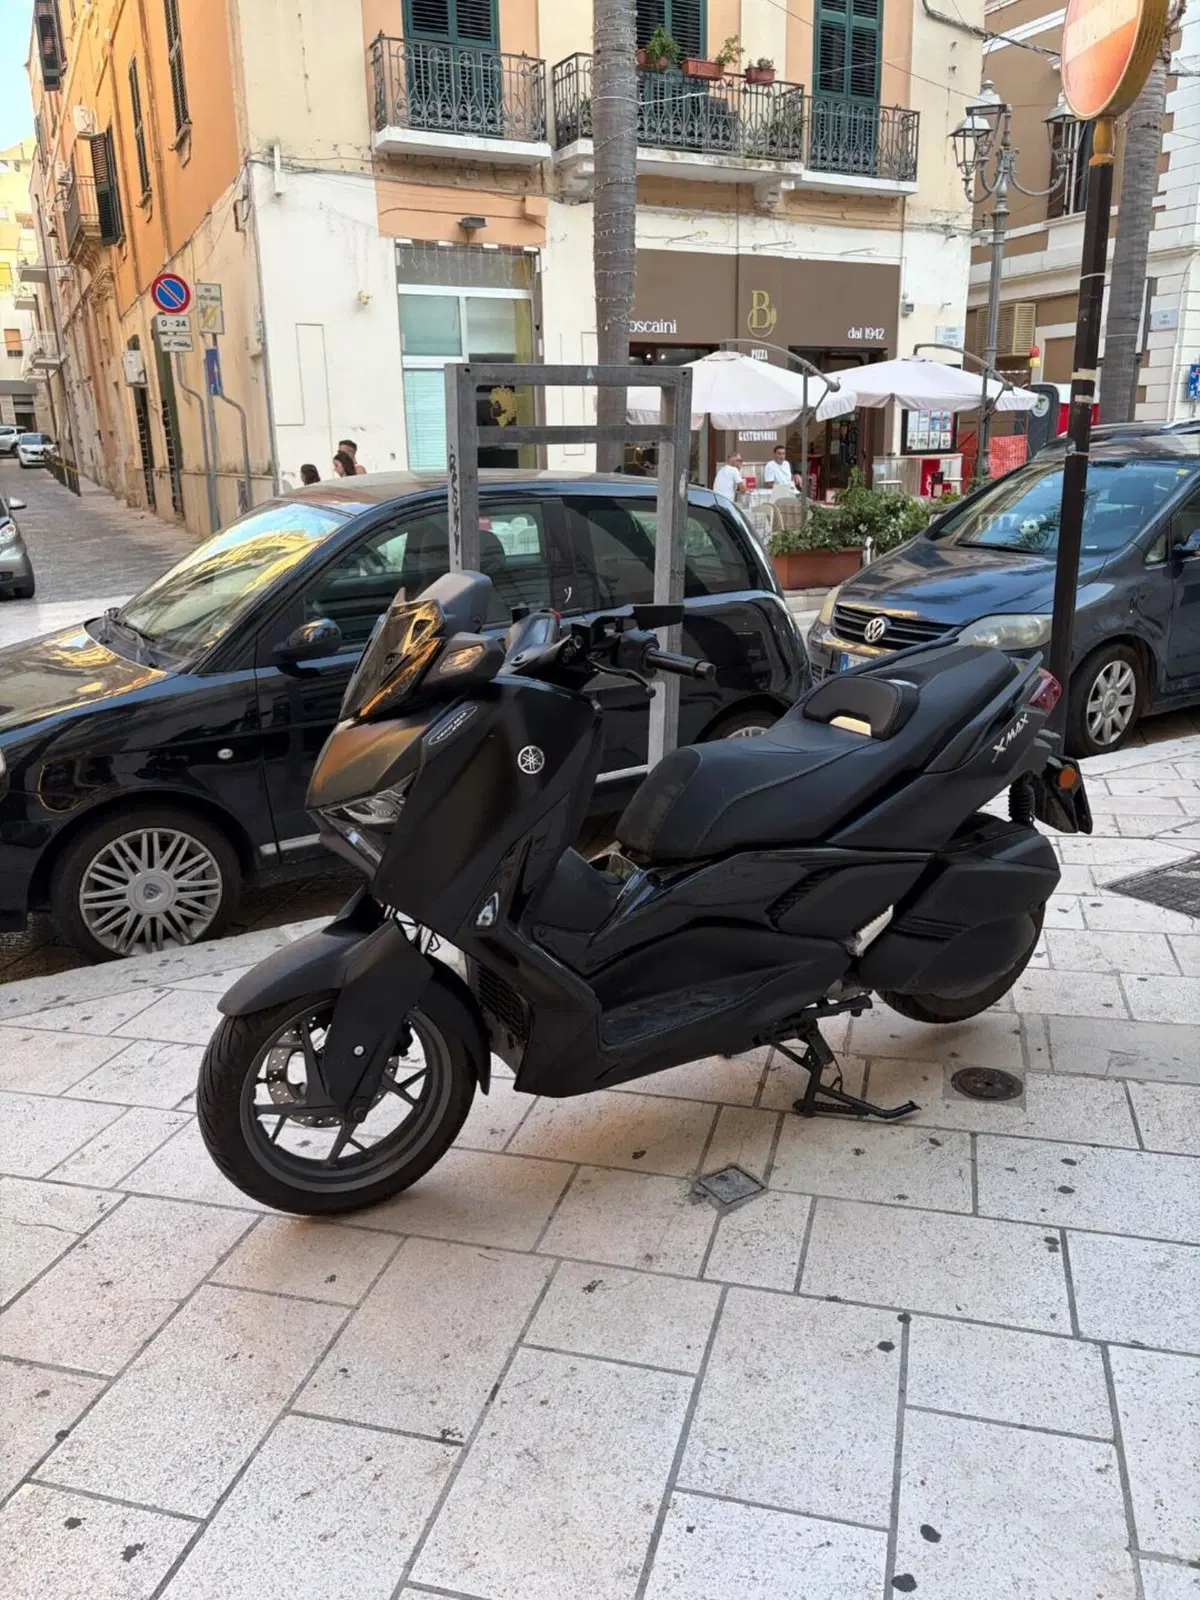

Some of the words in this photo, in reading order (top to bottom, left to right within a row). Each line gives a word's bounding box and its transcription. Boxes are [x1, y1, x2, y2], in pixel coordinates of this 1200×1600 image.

[175, 319, 187, 327] 24
[629, 318, 677, 333] oscaini
[847, 326, 862, 339] dal
[865, 327, 885, 340] 1942
